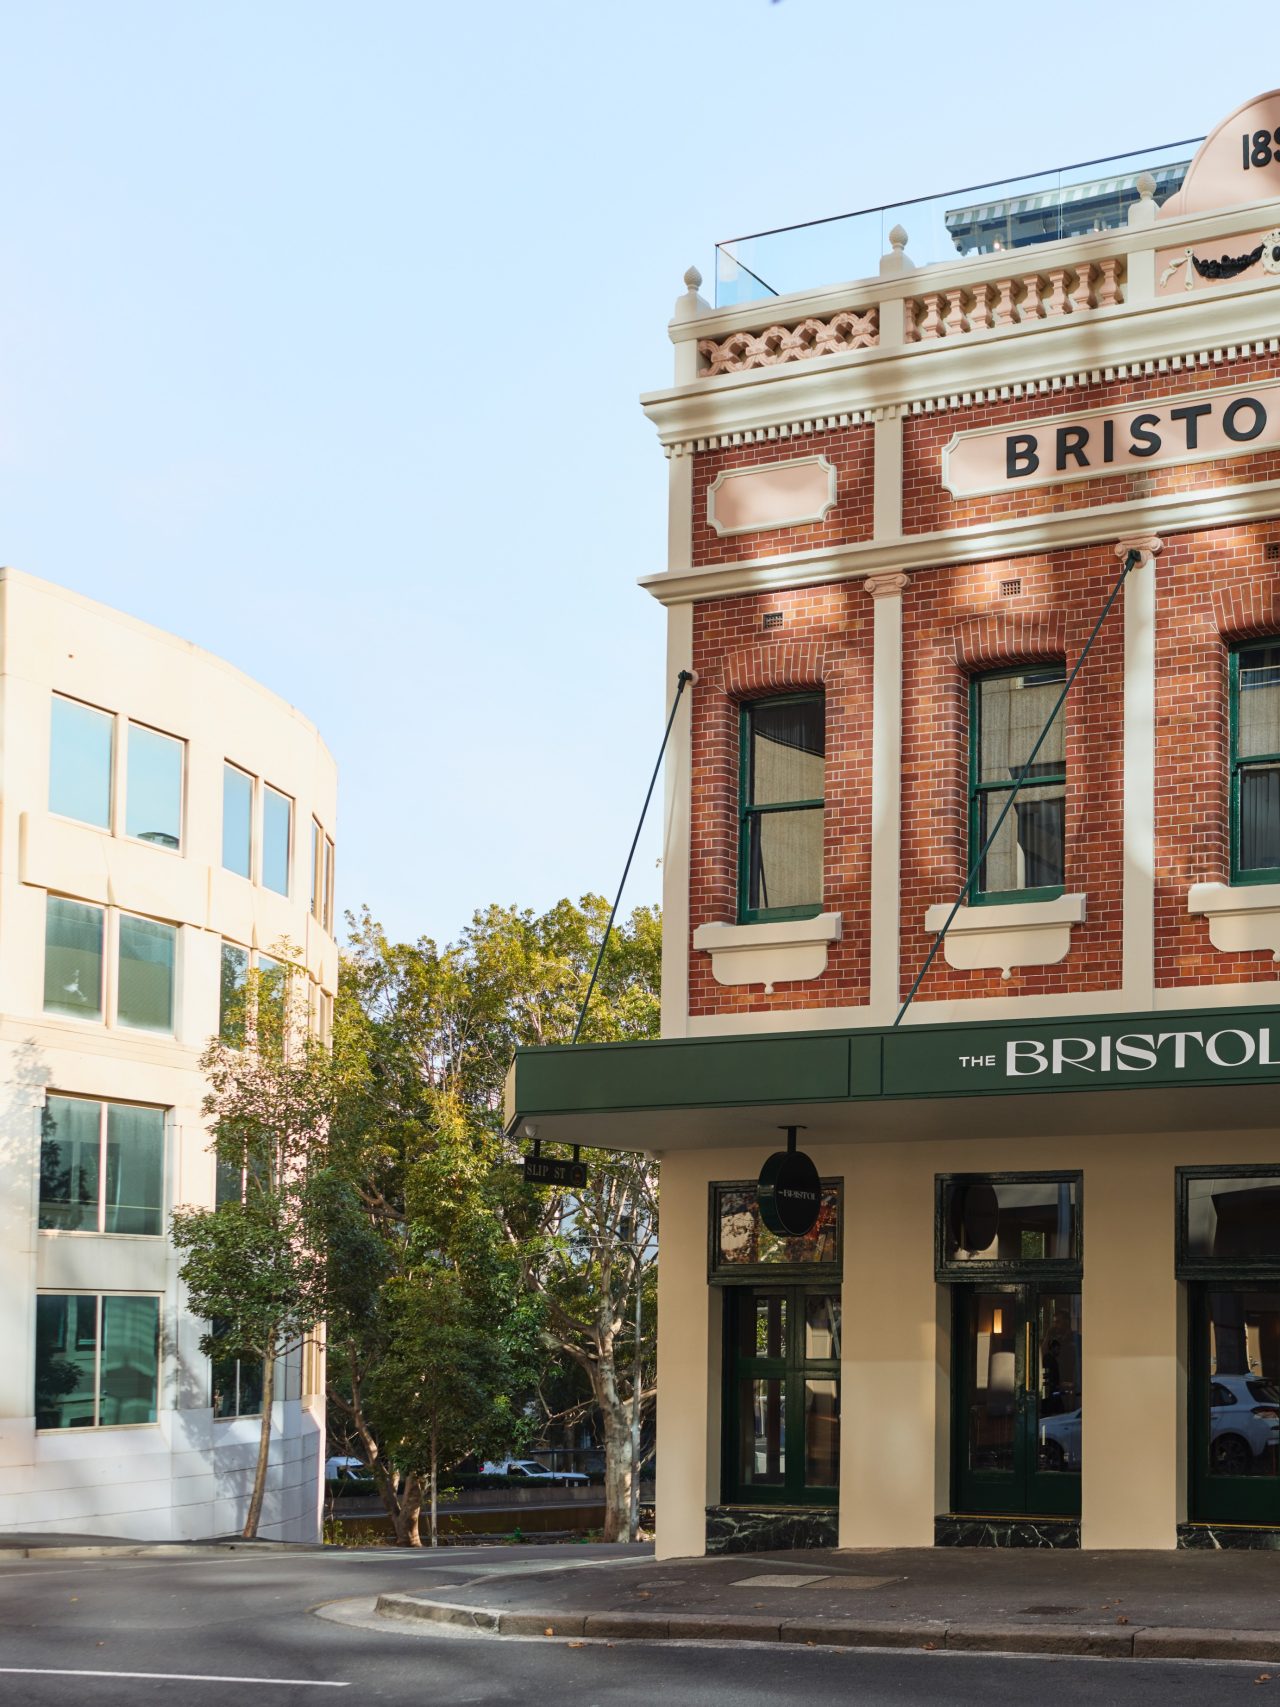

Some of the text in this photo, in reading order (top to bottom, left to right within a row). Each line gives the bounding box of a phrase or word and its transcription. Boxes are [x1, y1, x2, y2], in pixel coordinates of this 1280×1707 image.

[958, 1054, 997, 1069] THE
[526, 1164, 566, 1179] SLIP ST
